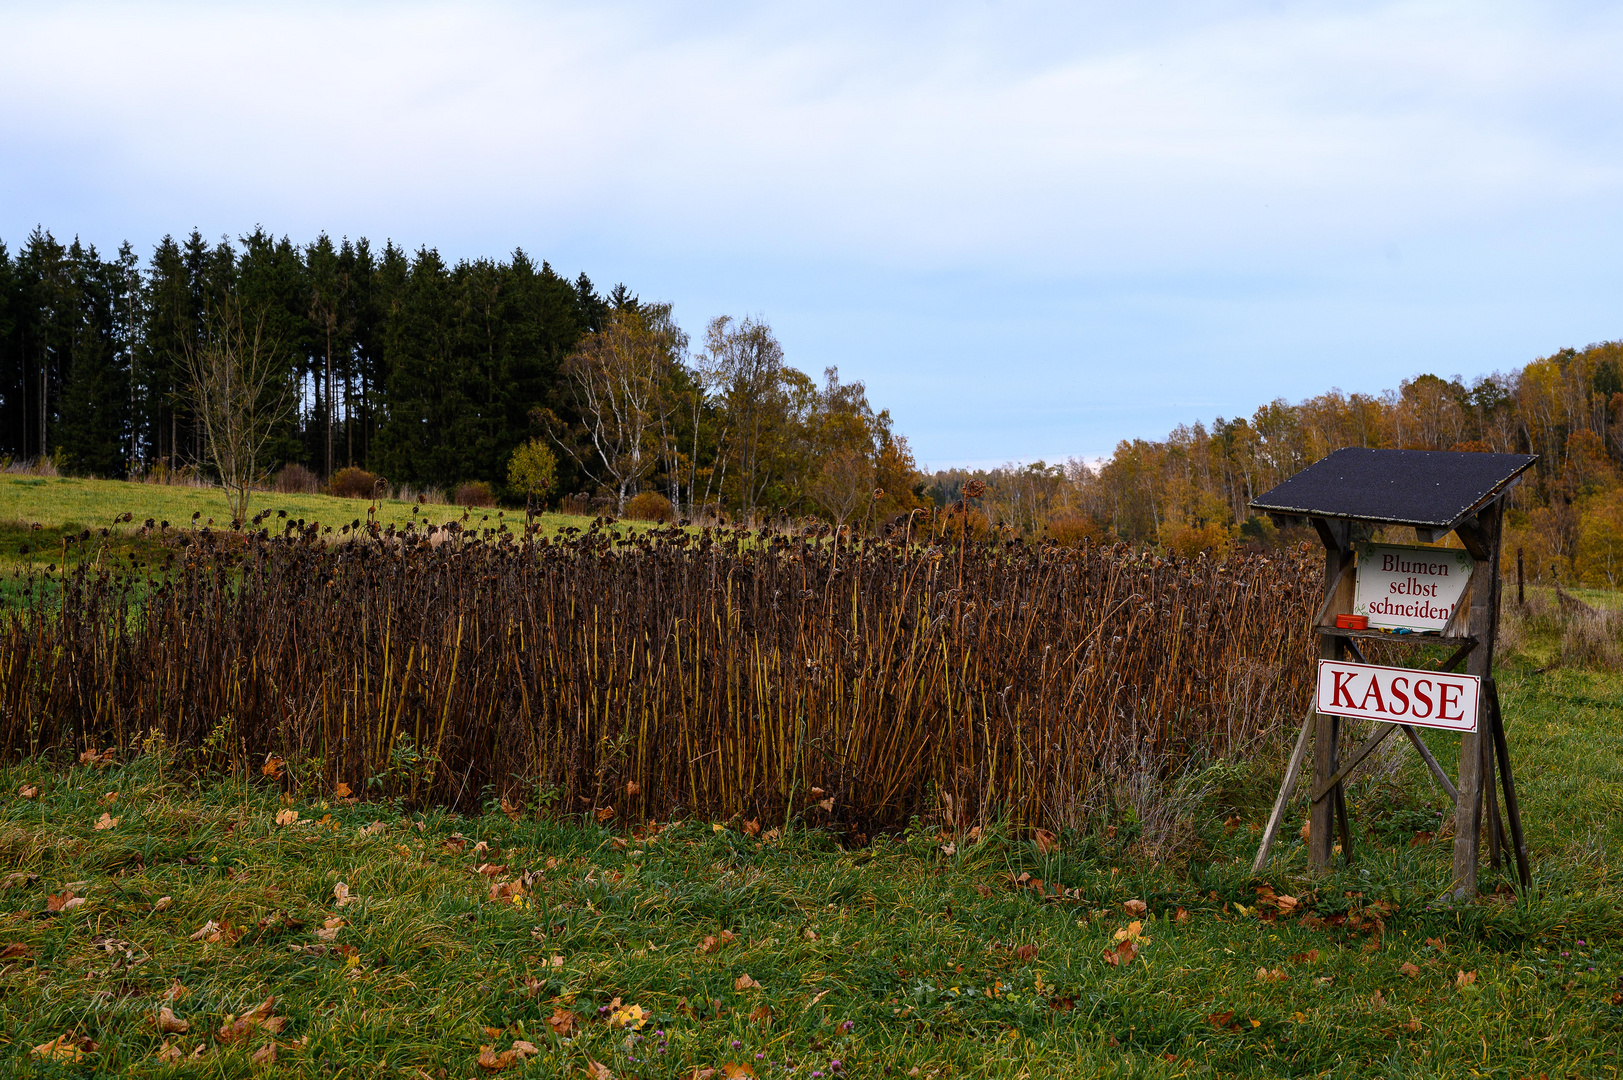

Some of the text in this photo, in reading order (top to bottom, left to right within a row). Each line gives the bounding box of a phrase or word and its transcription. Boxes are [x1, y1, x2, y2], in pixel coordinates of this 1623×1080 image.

[1381, 554, 1449, 576] Blumen
[1389, 578, 1438, 597] selbst
[1329, 671, 1465, 721] KASSE
